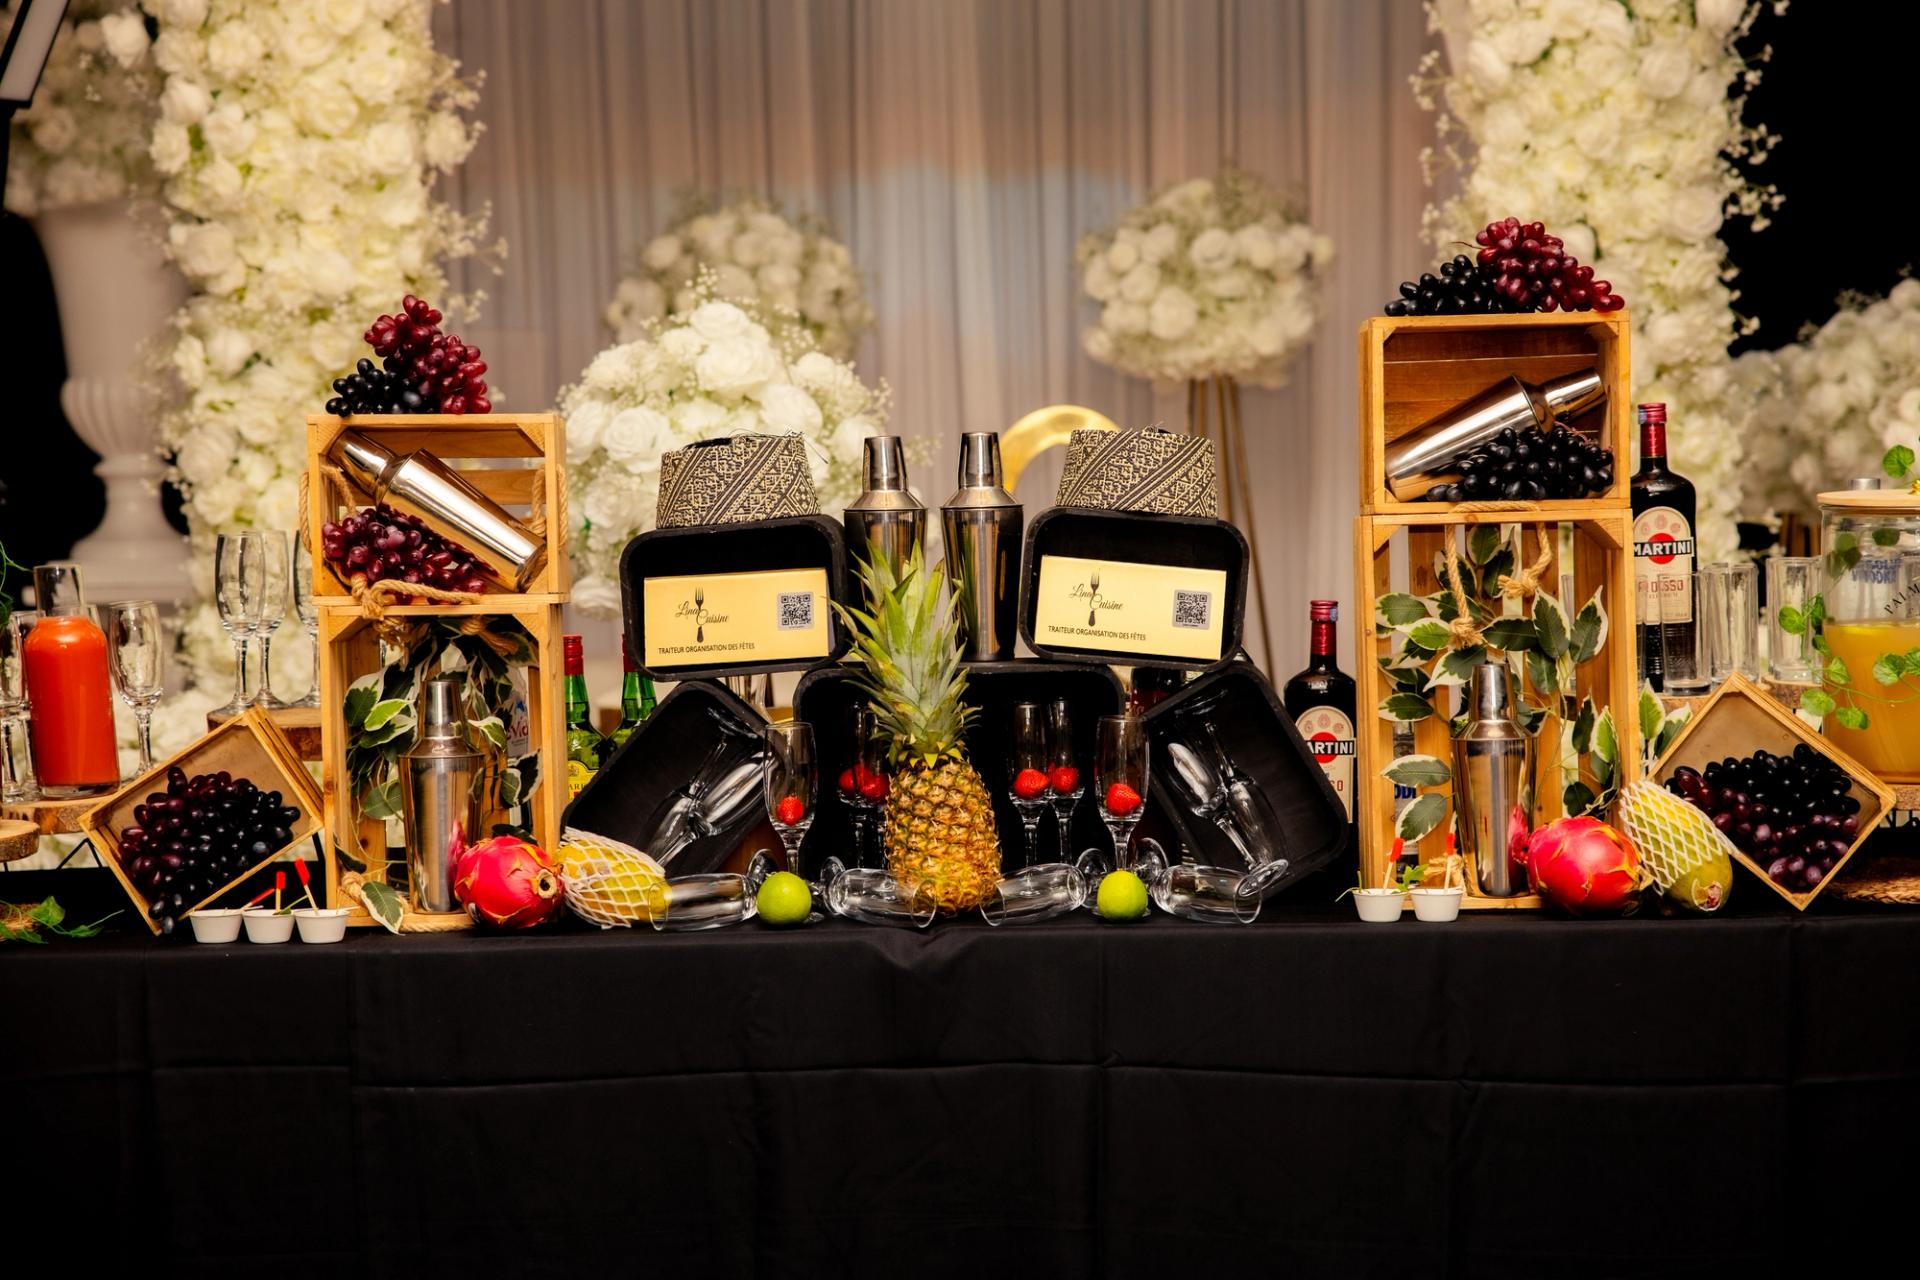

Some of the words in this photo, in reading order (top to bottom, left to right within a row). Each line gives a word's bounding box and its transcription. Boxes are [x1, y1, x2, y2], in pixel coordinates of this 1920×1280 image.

[1634, 542, 1690, 555] MARTINI
[1089, 593, 1124, 611] Cuisine
[696, 608, 729, 626] Cuisine
[1048, 625, 1075, 634] TRAITEUR
[1075, 628, 1118, 639] ORGANISATION
[1118, 631, 1130, 640] DES
[1130, 631, 1147, 641] FÊTES
[658, 646, 685, 655] TRAITEUR
[685, 643, 728, 653] ORGANISATION
[728, 642, 739, 651] DES
[739, 641, 756, 650] FÊTES
[1307, 742, 1353, 754] ARTINI
